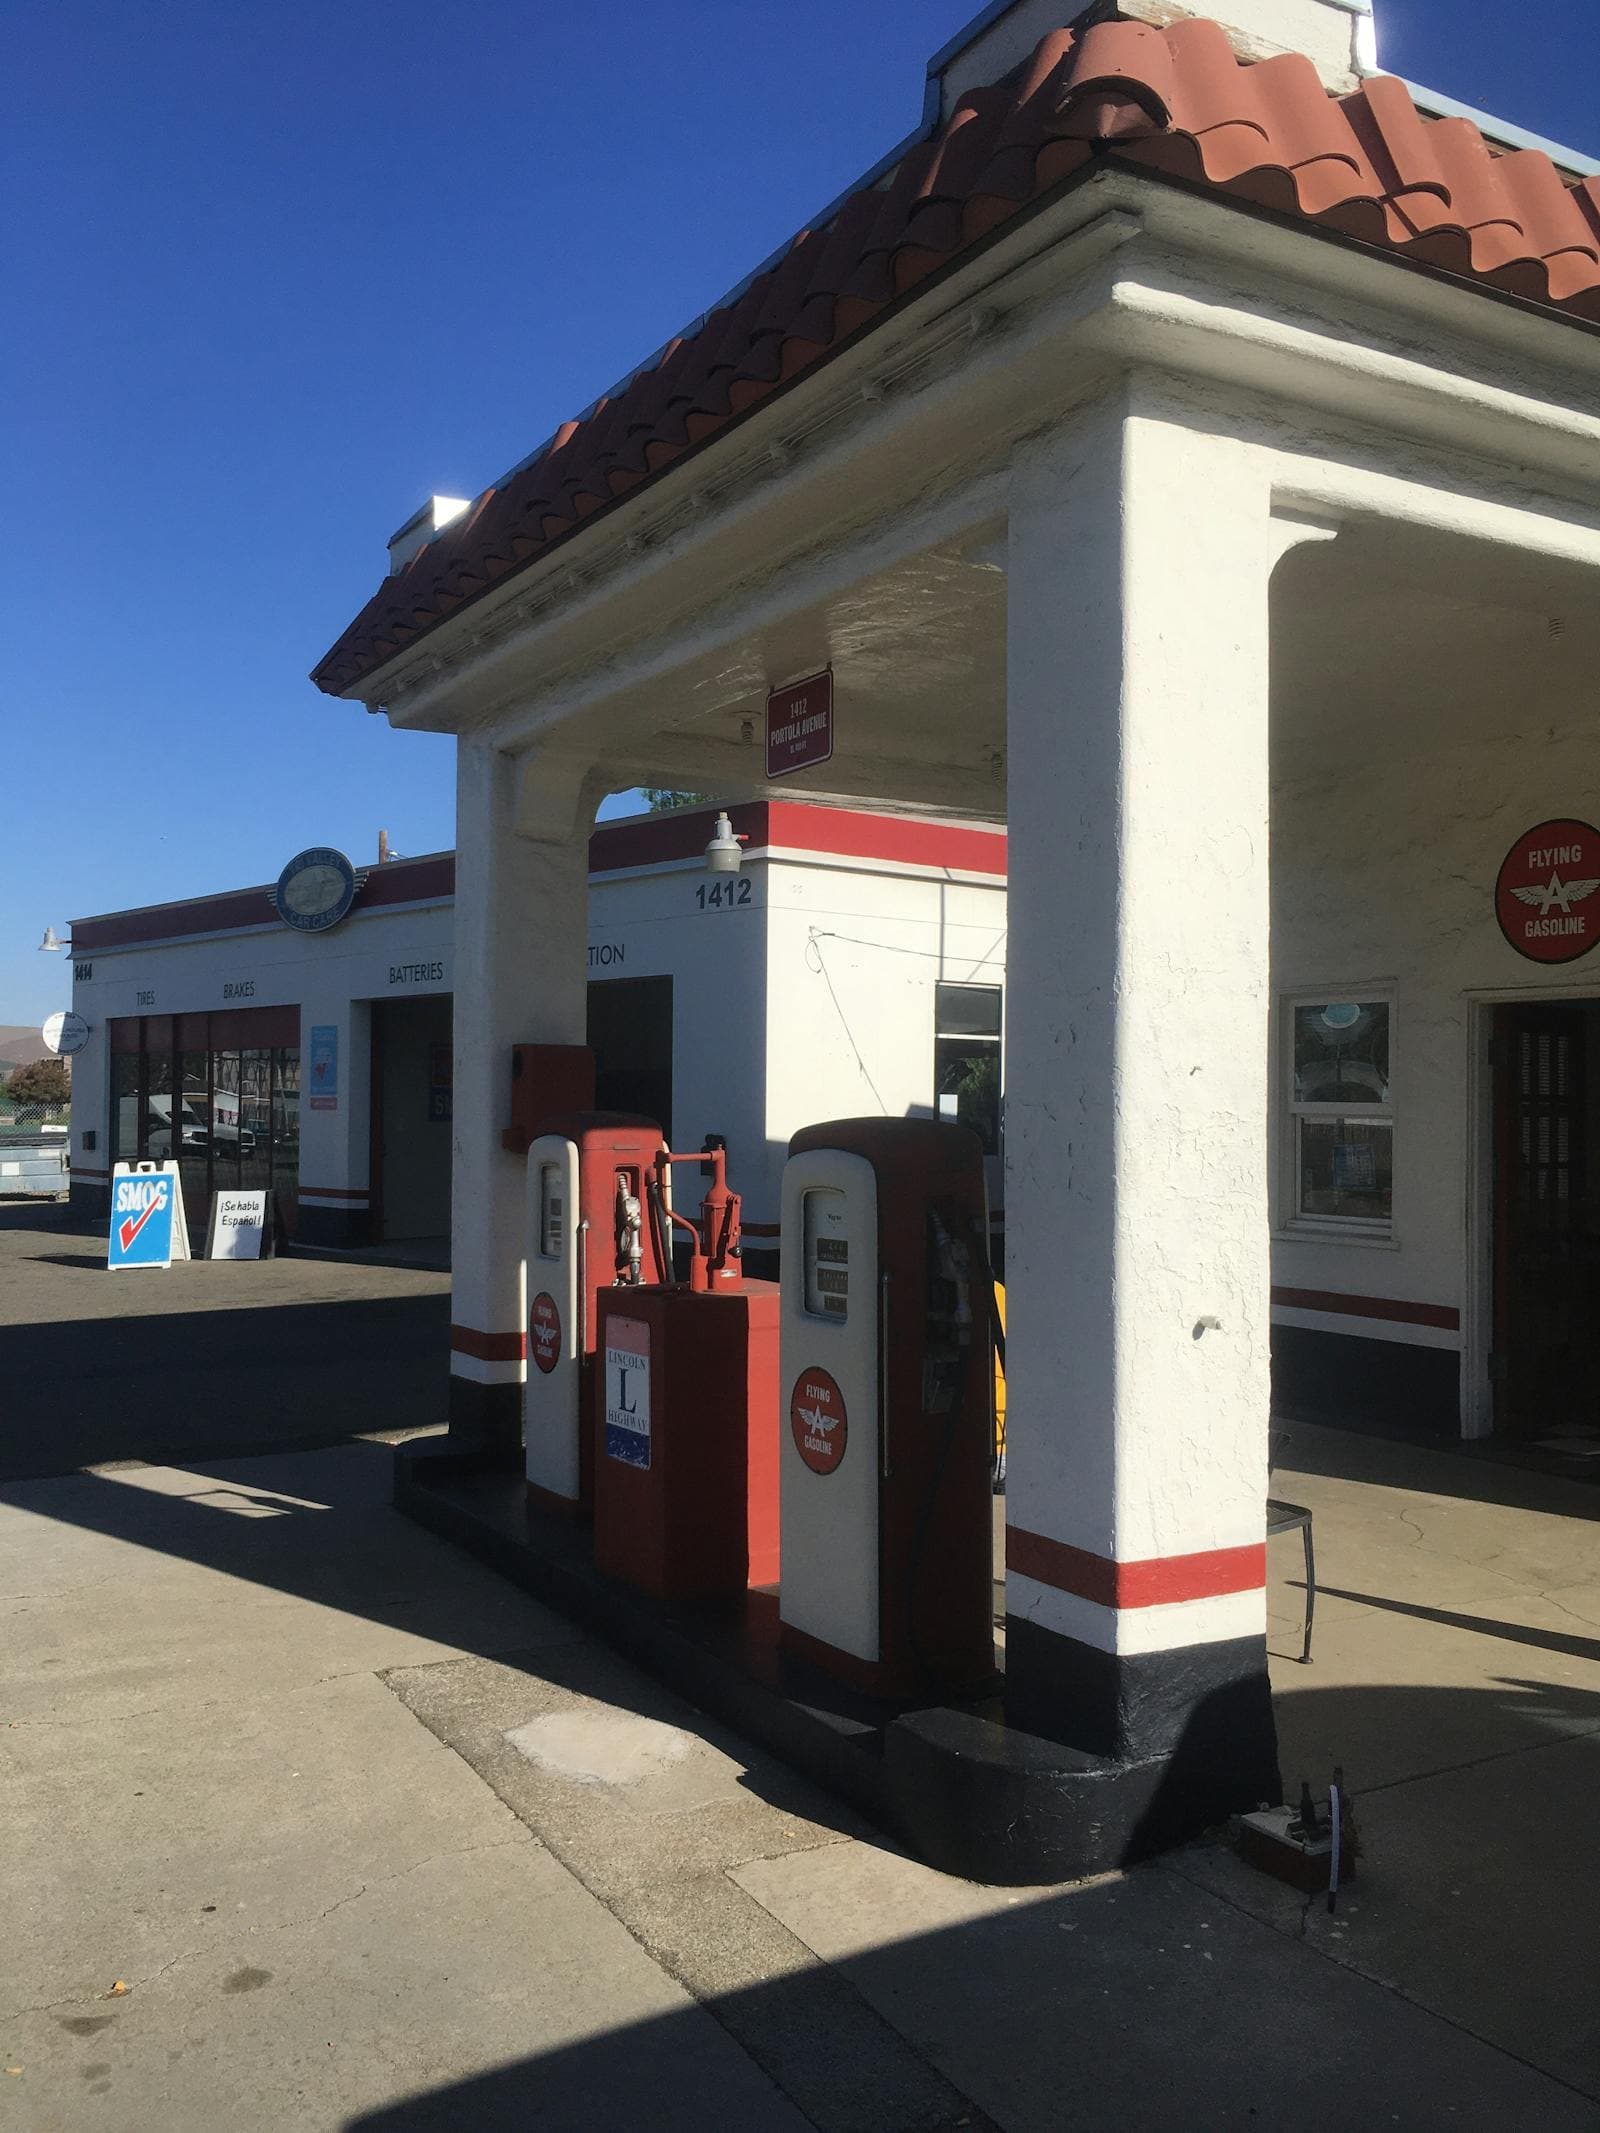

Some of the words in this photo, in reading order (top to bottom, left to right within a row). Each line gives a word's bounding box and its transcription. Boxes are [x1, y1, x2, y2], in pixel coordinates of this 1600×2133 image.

[790, 697, 807, 719] 1412
[770, 721, 800, 747] PORTOLA
[801, 711, 827, 735] AVENUE
[1528, 844, 1582, 869] FLYING
[695, 878, 752, 909] 1412
[1524, 916, 1585, 938] GASOLINE
[586, 943, 625, 965] TION
[389, 961, 444, 984] BATTERIES
[136, 990, 155, 1006] TIRES
[223, 981, 255, 999] BRAKES
[116, 1180, 168, 1213] SMOG
[237, 1199, 260, 1212] habla
[221, 1213, 262, 1228] Español!
[608, 1350, 646, 1370] LINCOLN
[618, 1367, 637, 1414] L
[805, 1383, 831, 1403] FLYING
[608, 1409, 646, 1431] HIGHWAY
[804, 1434, 833, 1456] GASOLINE
